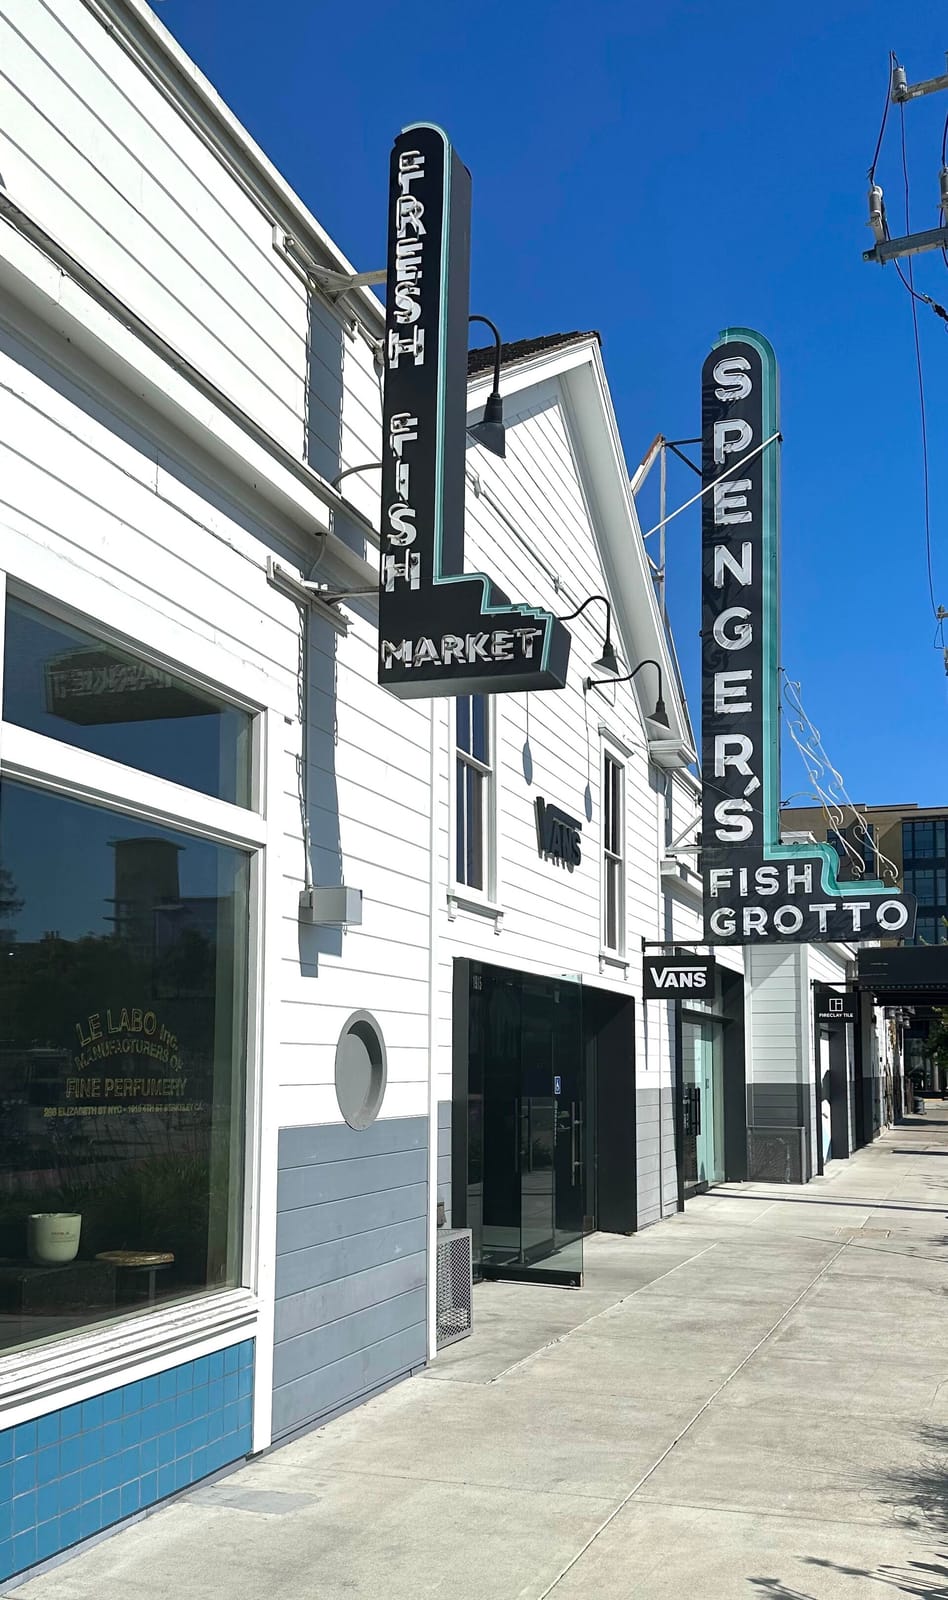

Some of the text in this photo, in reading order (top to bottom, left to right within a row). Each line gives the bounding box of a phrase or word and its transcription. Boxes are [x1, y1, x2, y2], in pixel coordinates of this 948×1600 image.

[388, 150, 427, 369] FRESH
[381, 412, 421, 592] FISH
[712, 356, 761, 842] SPENGER'S
[381, 627, 542, 669] MARKET
[709, 864, 812, 898] FISH
[709, 900, 909, 937] GROTTO
[650, 967, 708, 988] VANS
[75, 1013, 103, 1047] LE
[106, 1007, 157, 1035] LABO
[65, 1077, 187, 1099] FINE PERFUMERY
